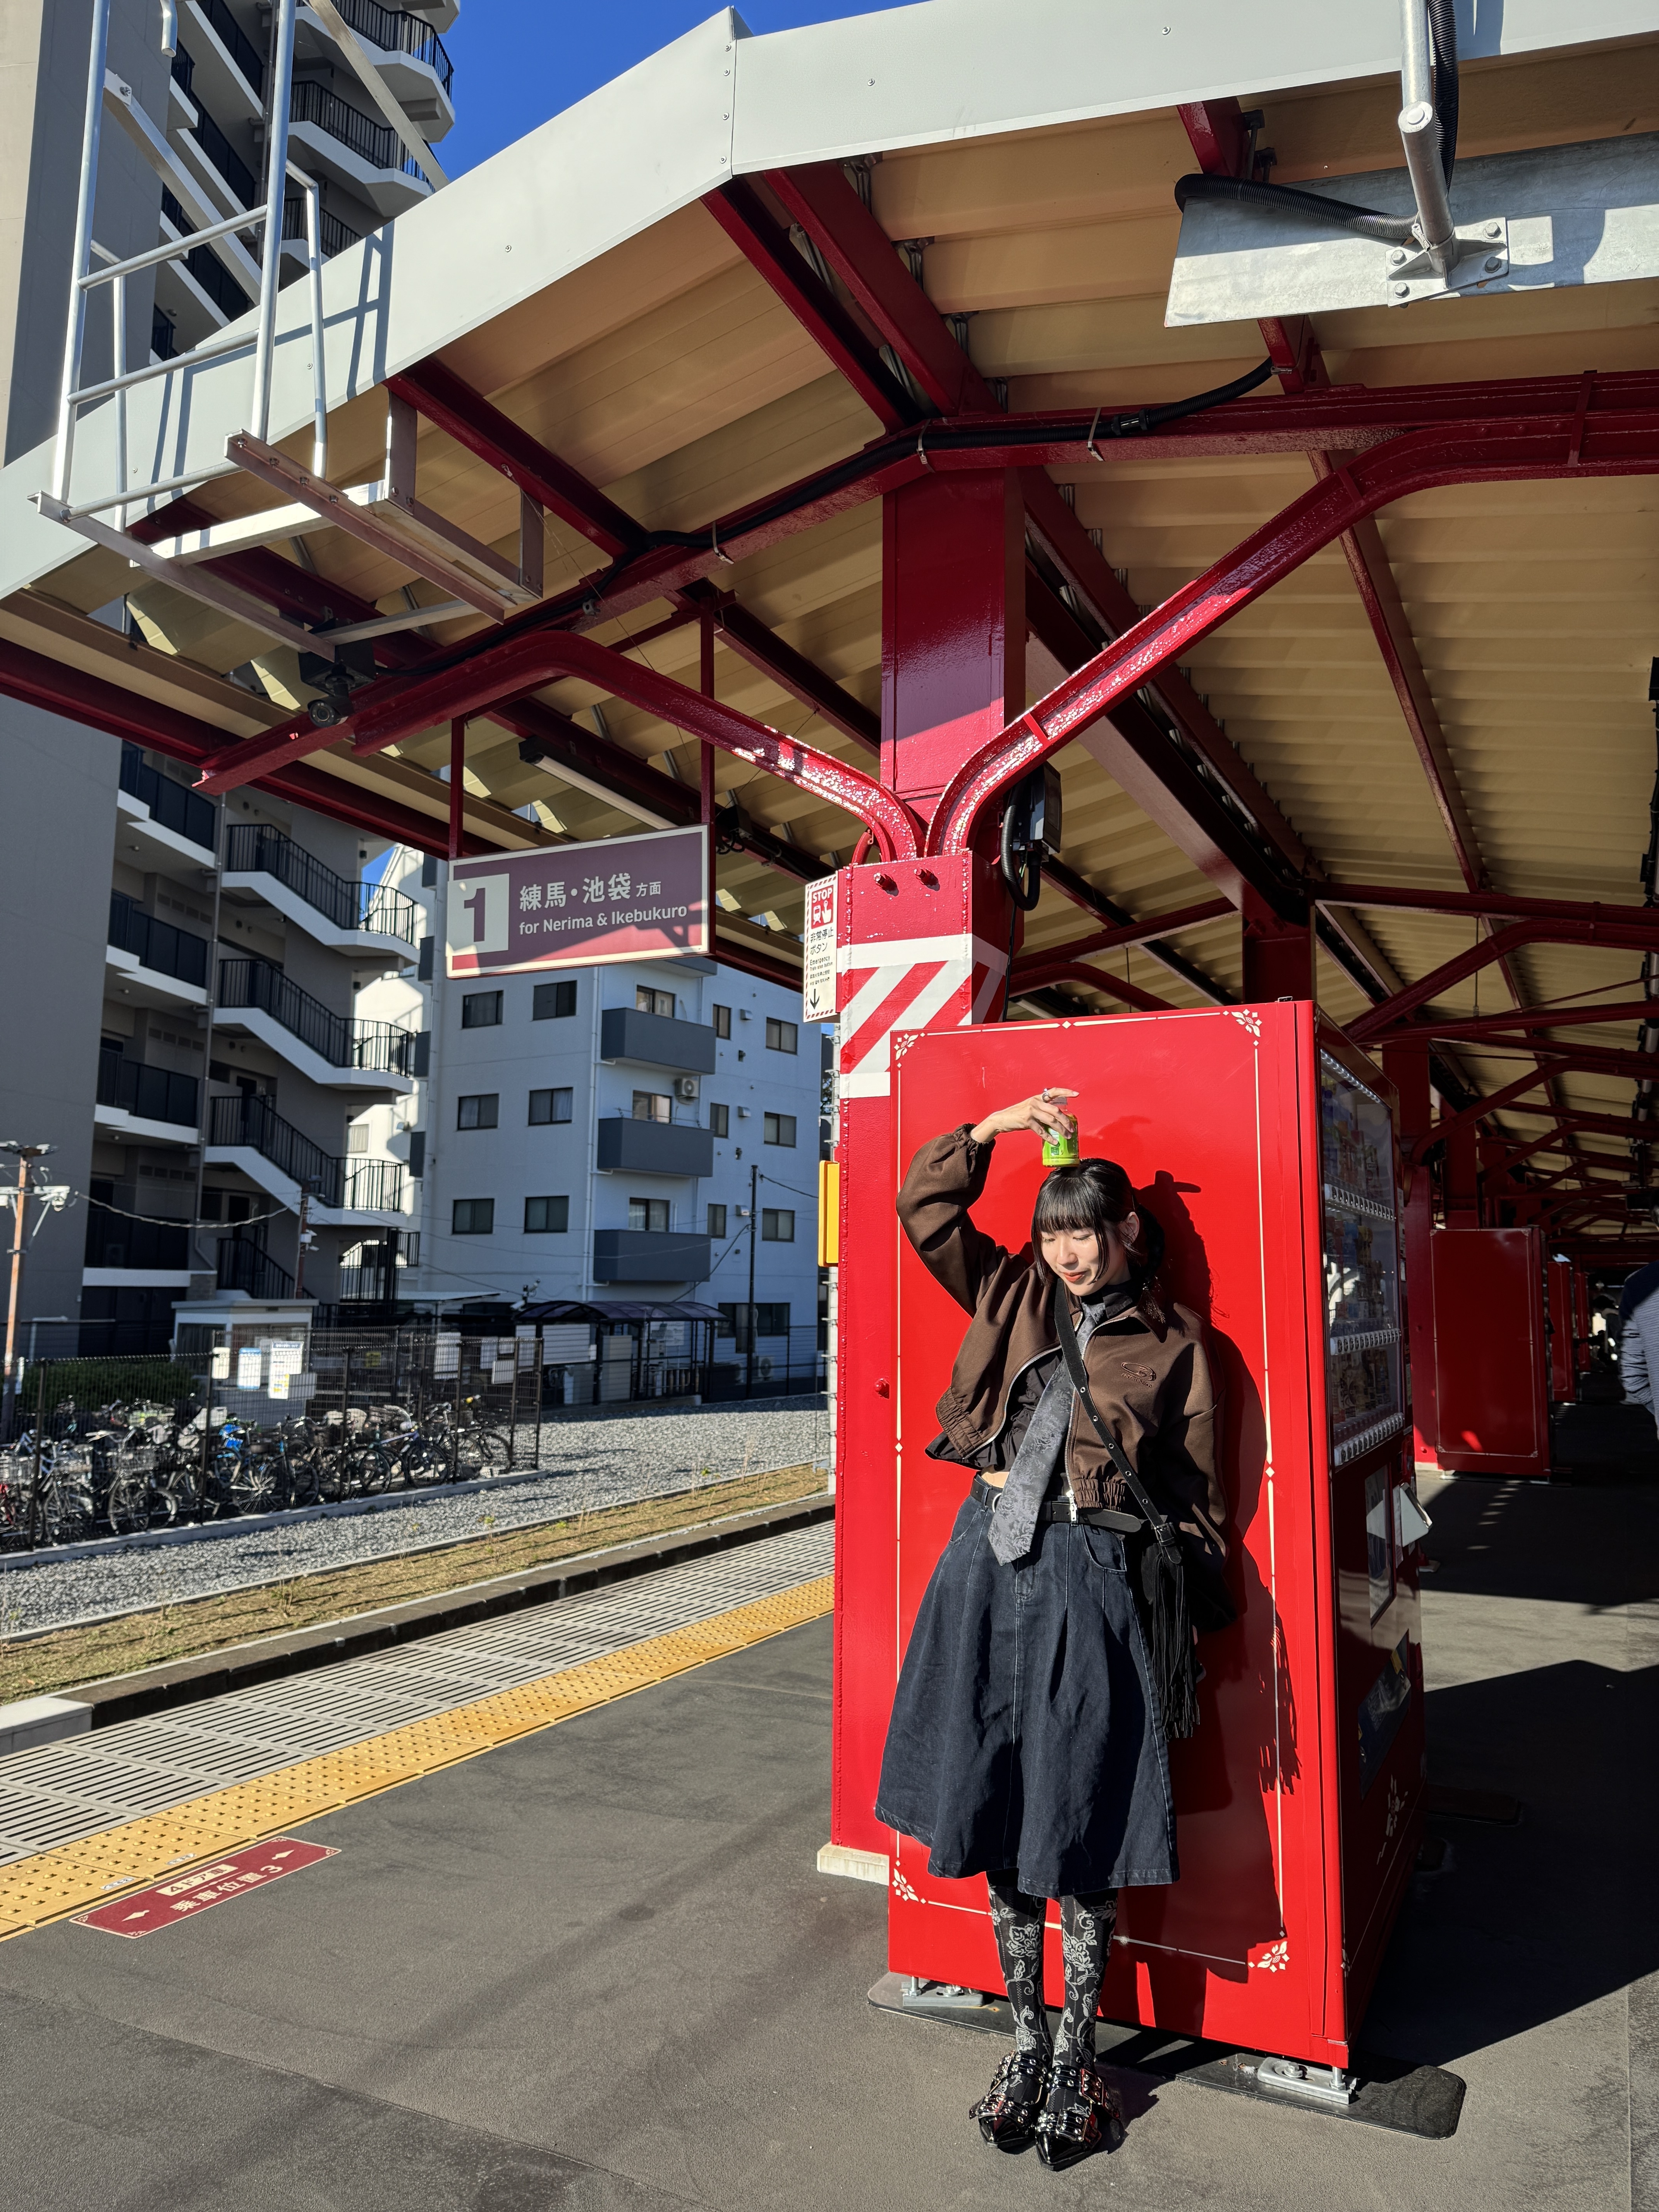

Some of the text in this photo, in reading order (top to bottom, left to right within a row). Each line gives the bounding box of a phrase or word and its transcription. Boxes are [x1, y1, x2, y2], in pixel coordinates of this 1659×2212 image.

[520, 873, 661, 911] 練馬・池袋 方面
[812, 887, 833, 903] STOP
[464, 888, 486, 942] 1
[520, 906, 687, 935] for Nerima & Ikebukuro
[810, 927, 834, 943] 非常停止
[810, 942, 828, 955] ボタン
[810, 956, 830, 966] Emergency
[170, 1868, 228, 1893] 4ドア車
